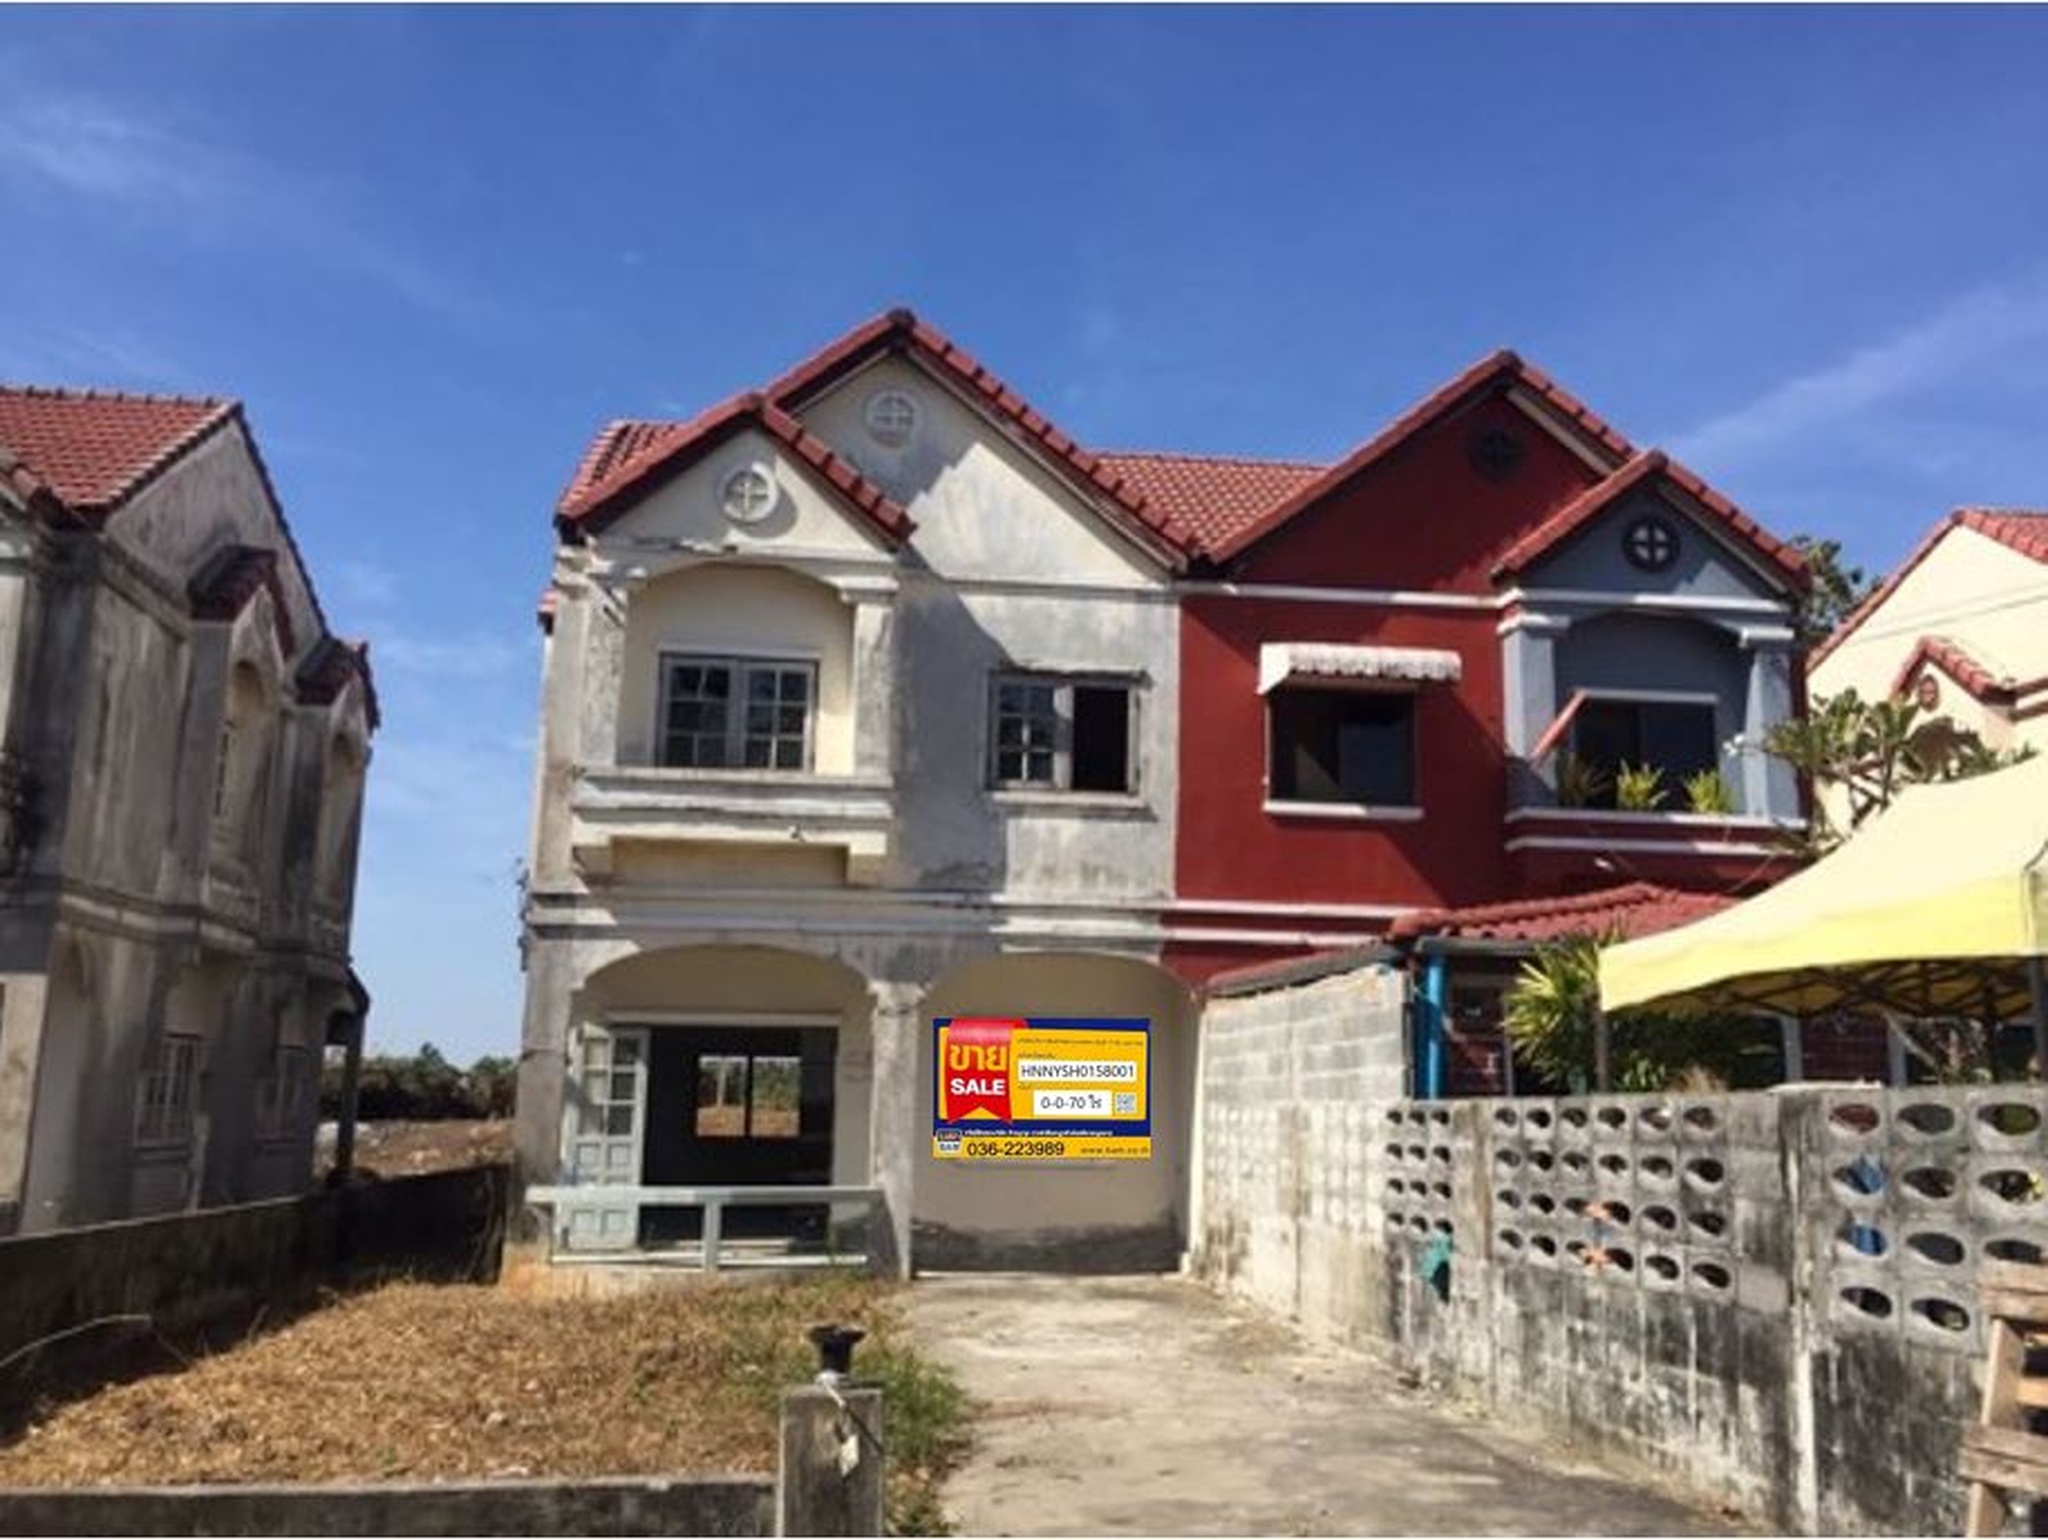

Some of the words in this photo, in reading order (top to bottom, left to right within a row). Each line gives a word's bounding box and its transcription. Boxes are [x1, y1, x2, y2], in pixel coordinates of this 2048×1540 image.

[950, 1045, 1007, 1071] ขาย
[1021, 1065, 1134, 1077] HNNYSH0158001
[950, 1078, 1006, 1096] SALE
[1040, 1096, 1086, 1109] 0-0-70
[966, 1142, 1065, 1156] 036-223989
